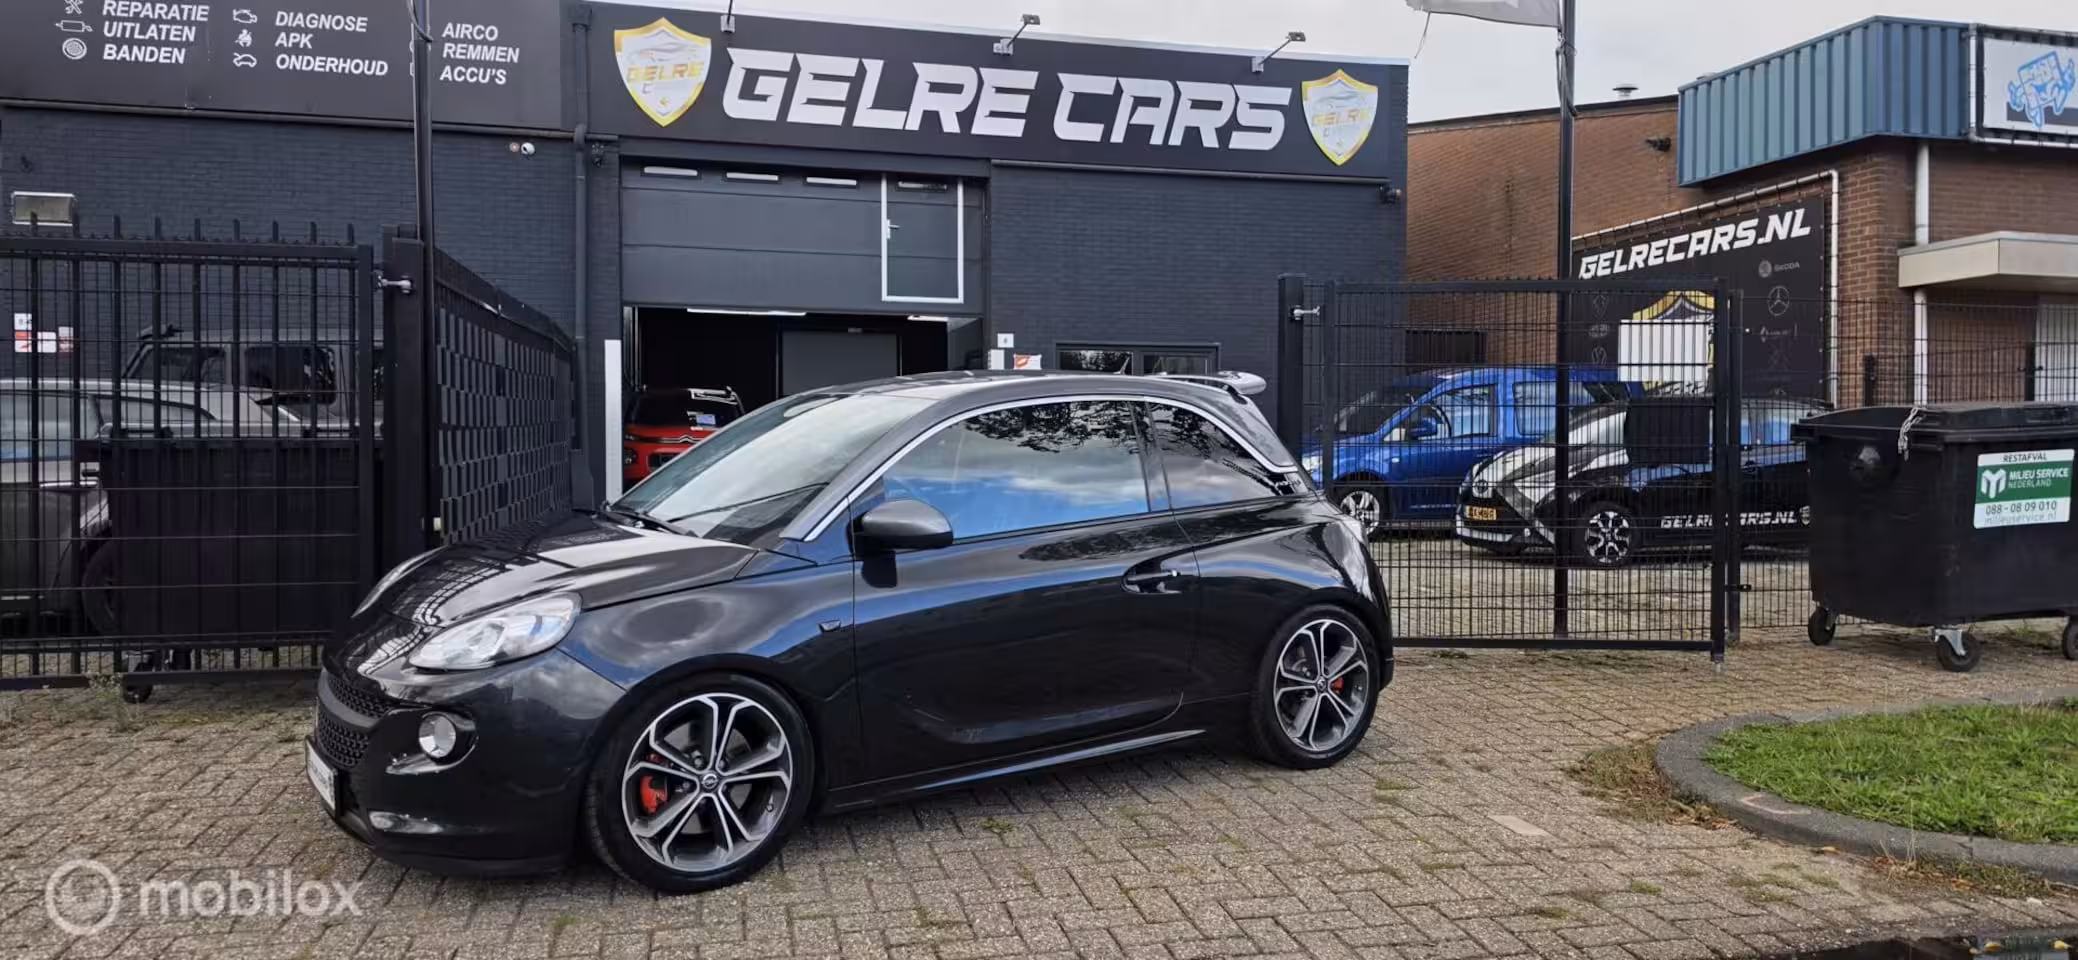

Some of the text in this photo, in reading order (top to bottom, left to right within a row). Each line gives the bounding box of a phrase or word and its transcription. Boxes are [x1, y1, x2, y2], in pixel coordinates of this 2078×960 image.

[102, 0, 210, 21] REPARATIE
[275, 10, 368, 32] DIAGNOSE
[103, 21, 196, 42] UITLATEN
[275, 31, 313, 49] APK
[441, 22, 498, 41] AIRCO
[103, 43, 186, 64] BANDEN
[442, 42, 520, 63] REMMEN
[276, 53, 388, 76] ONDERHOUD
[440, 65, 507, 85] ACCU'S
[722, 47, 1291, 151] GELRE CARS
[1578, 207, 1811, 280] GELRECARS.NL
[2003, 453, 2047, 463] RESTAFVAL
[2008, 479, 2052, 489] NEDERLAND
[2009, 468, 2070, 480] MILIEU SERVICE
